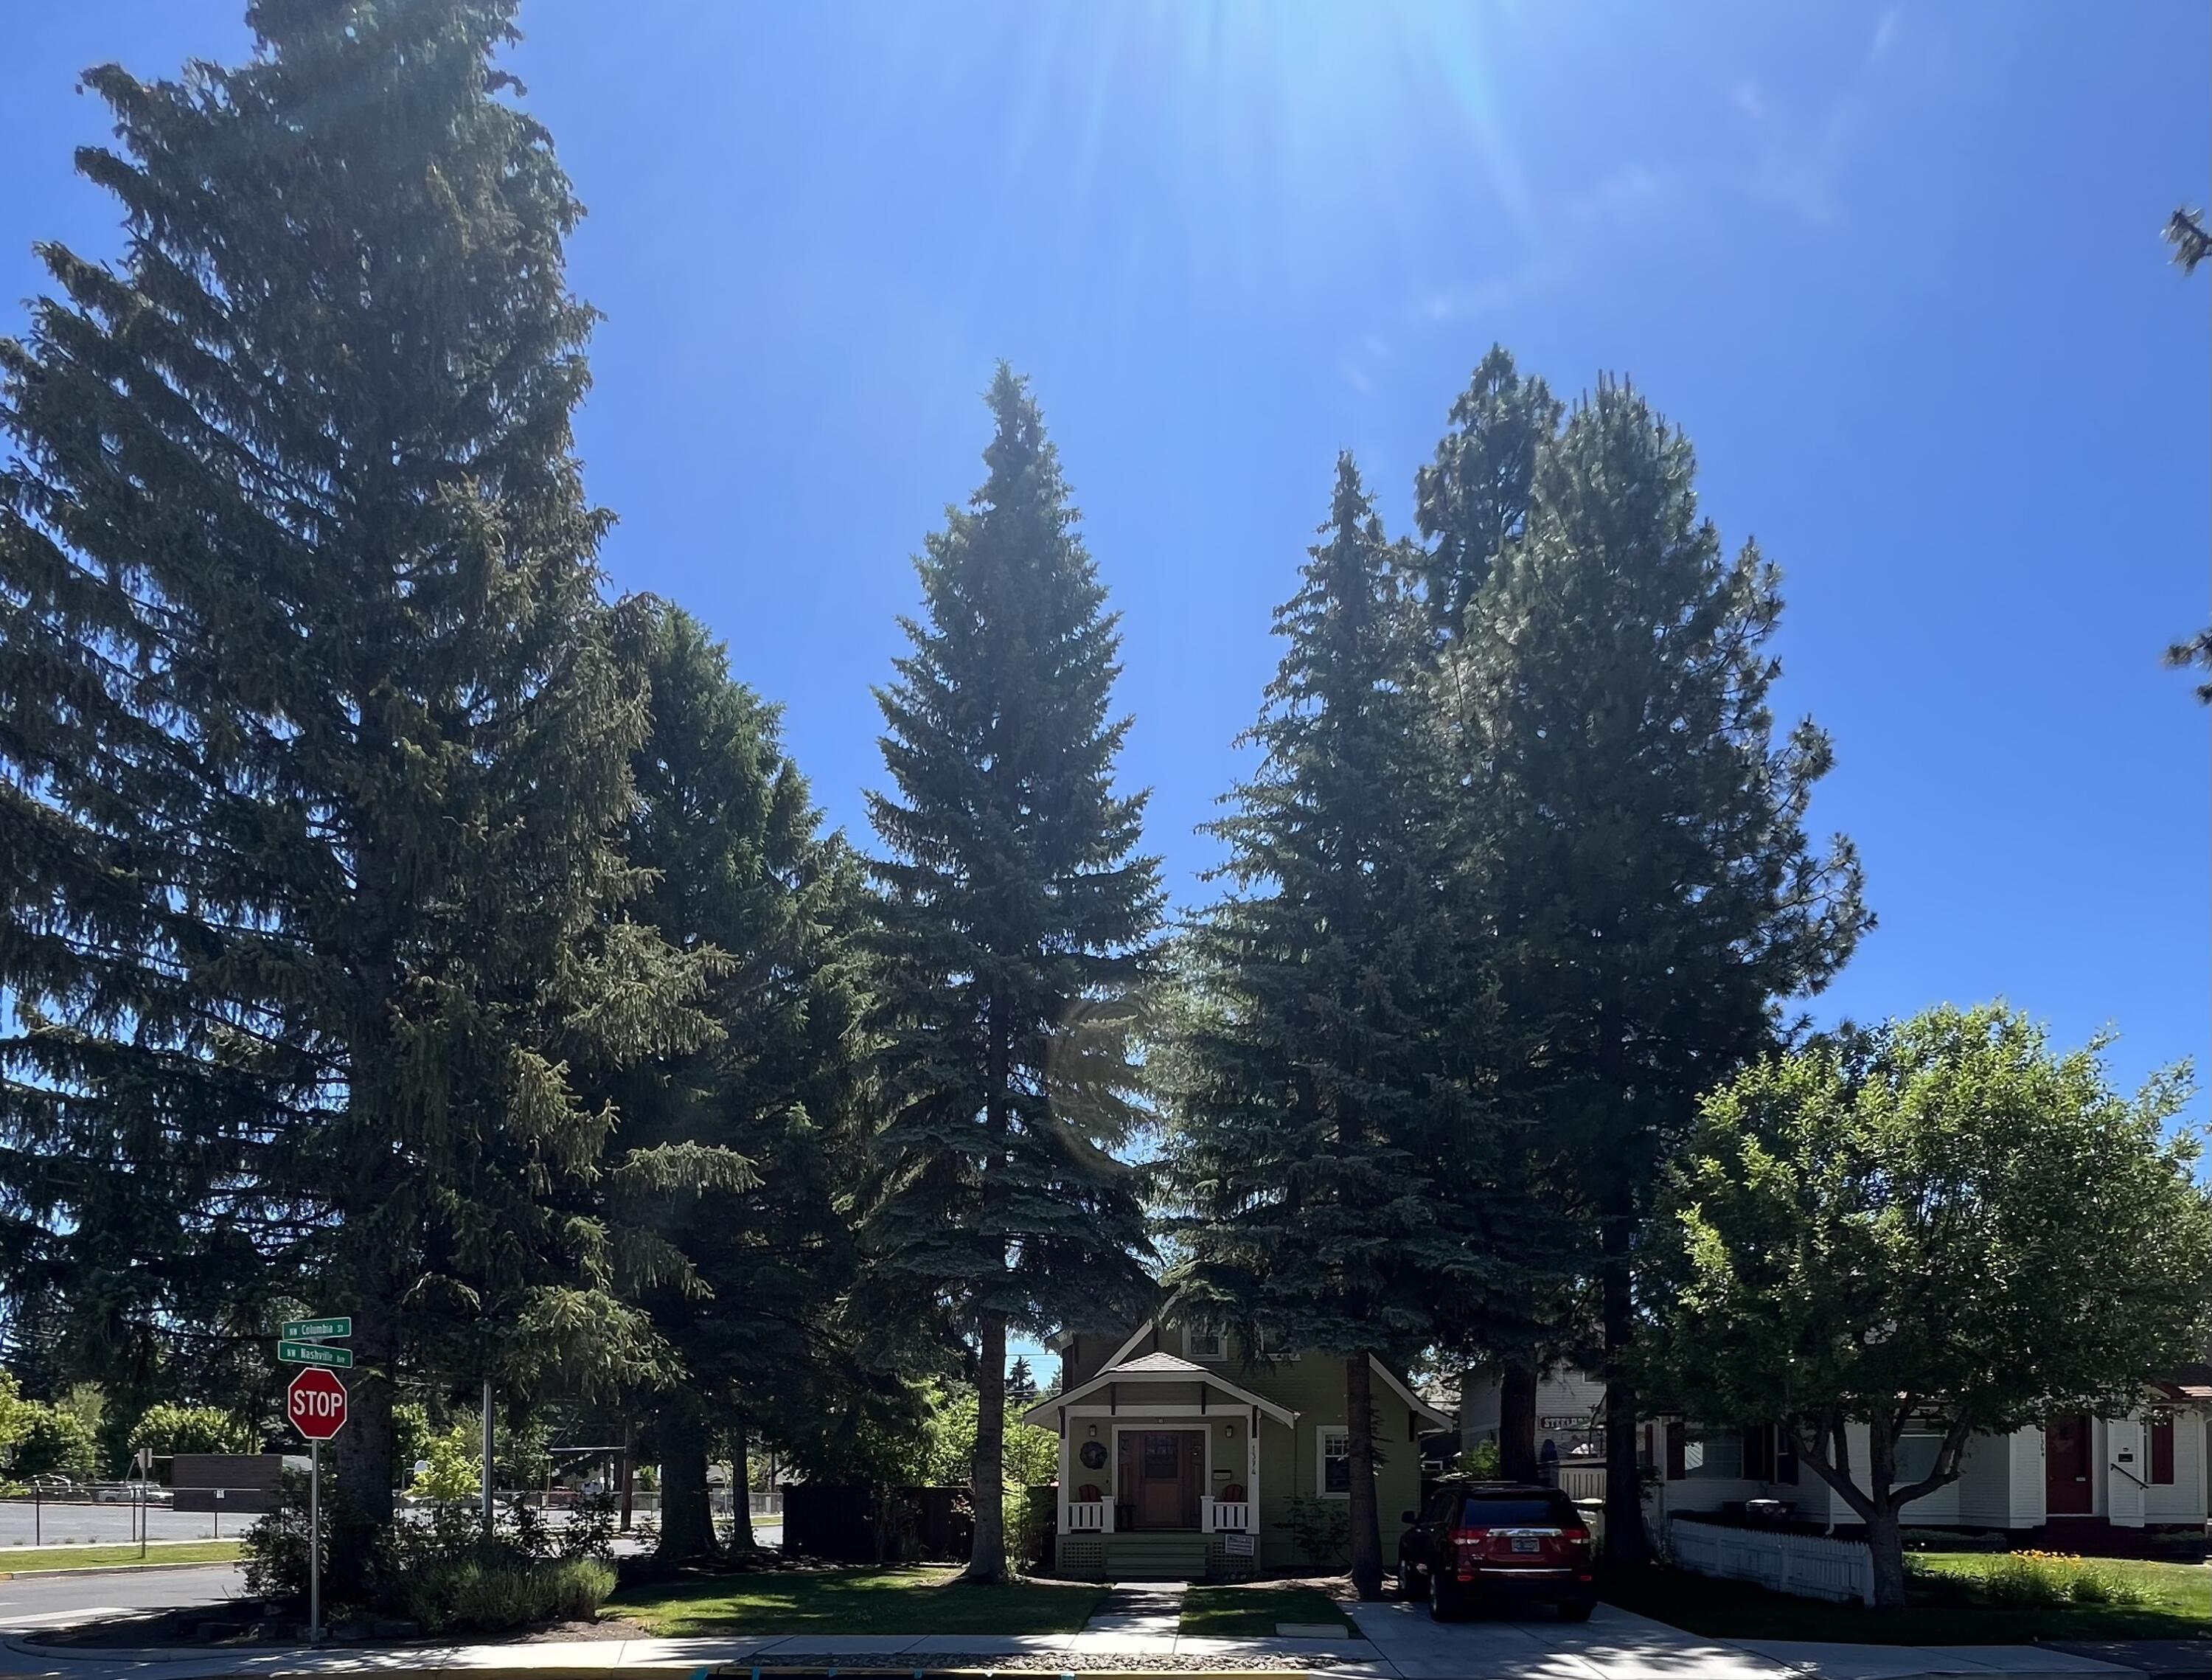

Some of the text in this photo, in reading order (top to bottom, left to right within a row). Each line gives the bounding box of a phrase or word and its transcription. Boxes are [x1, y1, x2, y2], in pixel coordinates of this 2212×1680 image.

[289, 1327, 297, 1336] NW
[302, 1324, 333, 1335] Columbia
[287, 1348, 296, 1357] NW
[301, 1347, 333, 1361] Nashville
[293, 1389, 343, 1417] STOP
